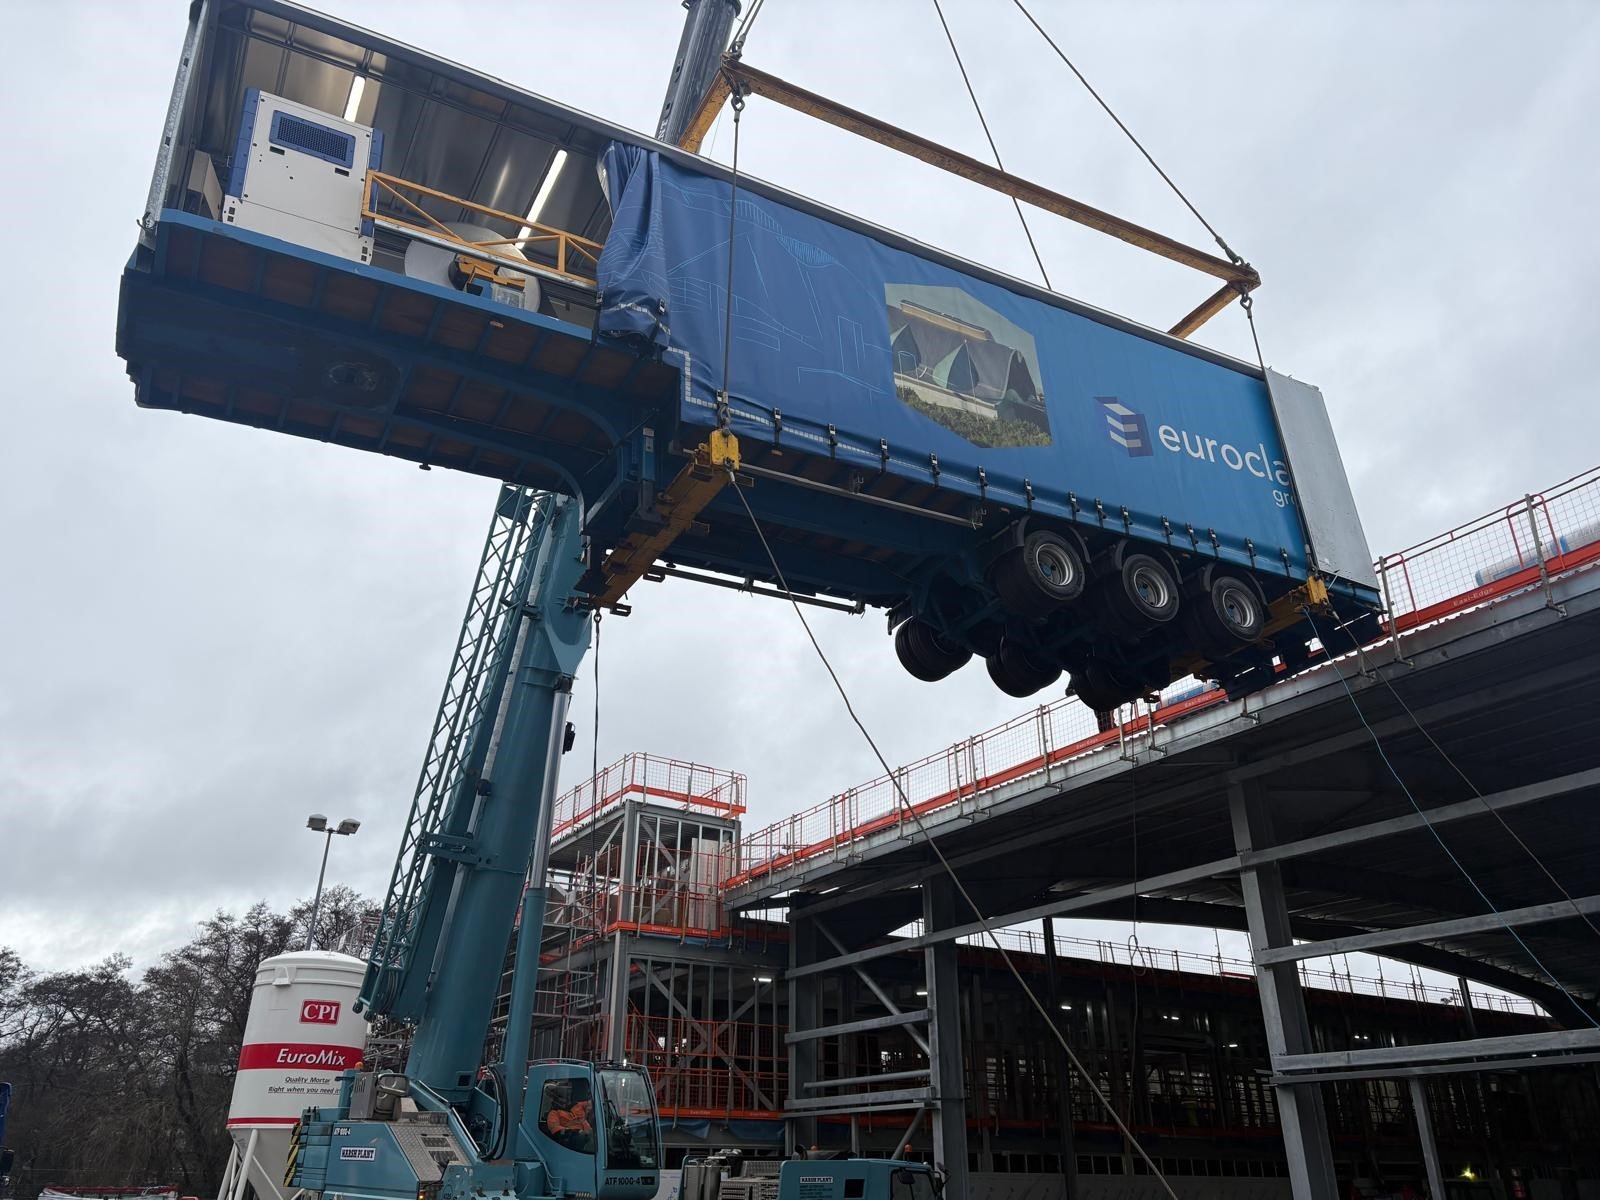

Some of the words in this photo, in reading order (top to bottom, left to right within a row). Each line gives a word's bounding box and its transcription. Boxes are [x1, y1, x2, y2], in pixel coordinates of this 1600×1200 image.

[1272, 489, 1295, 507] gr
[303, 1003, 339, 1021] CPI
[276, 1049, 346, 1066] EuroMix
[285, 1076, 308, 1084] Quality
[357, 1149, 374, 1159] PLANT
[605, 1176, 617, 1185] ATF
